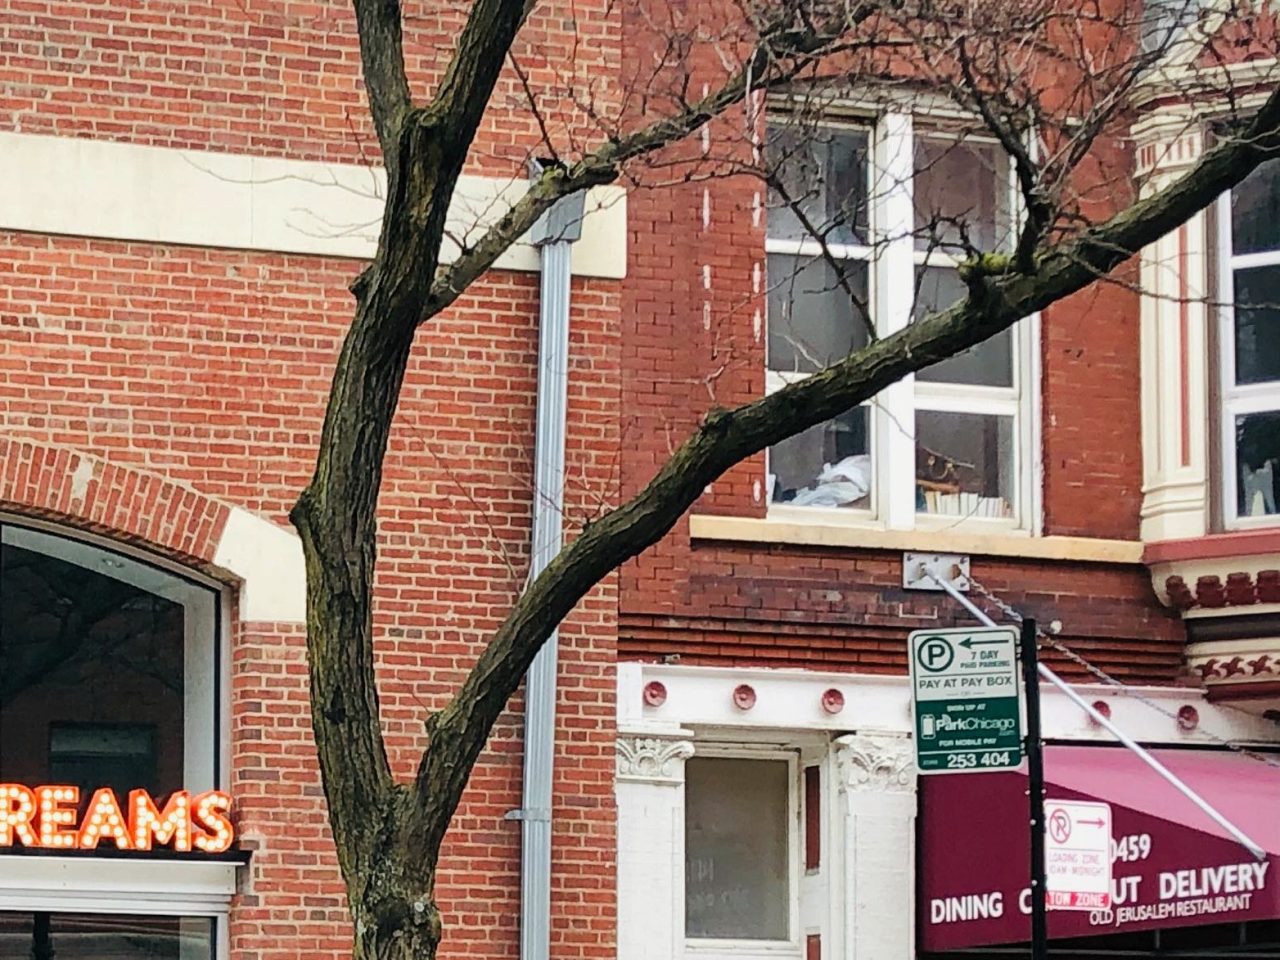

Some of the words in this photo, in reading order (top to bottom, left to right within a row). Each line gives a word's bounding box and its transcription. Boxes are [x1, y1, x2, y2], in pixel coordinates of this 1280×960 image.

[980, 650, 999, 660] DAY
[919, 680, 941, 689] PAY
[943, 678, 958, 688] AT
[961, 678, 983, 687] PAY
[987, 676, 1013, 686] BOX
[935, 715, 1015, 731] ParkChicago
[939, 739, 954, 747] FOR
[947, 753, 977, 768] 253
[980, 752, 1010, 767] 404
[930, 892, 1003, 924] DINING
[1111, 876, 1142, 905] UT
[1159, 861, 1270, 900] DELIVERY
[1049, 892, 1071, 906] TOW
[1076, 892, 1105, 907] ZONE
[1089, 909, 1114, 926] OLD
[1115, 903, 1177, 927] JERUSALEM
[1177, 893, 1253, 917] RESTAURANT
